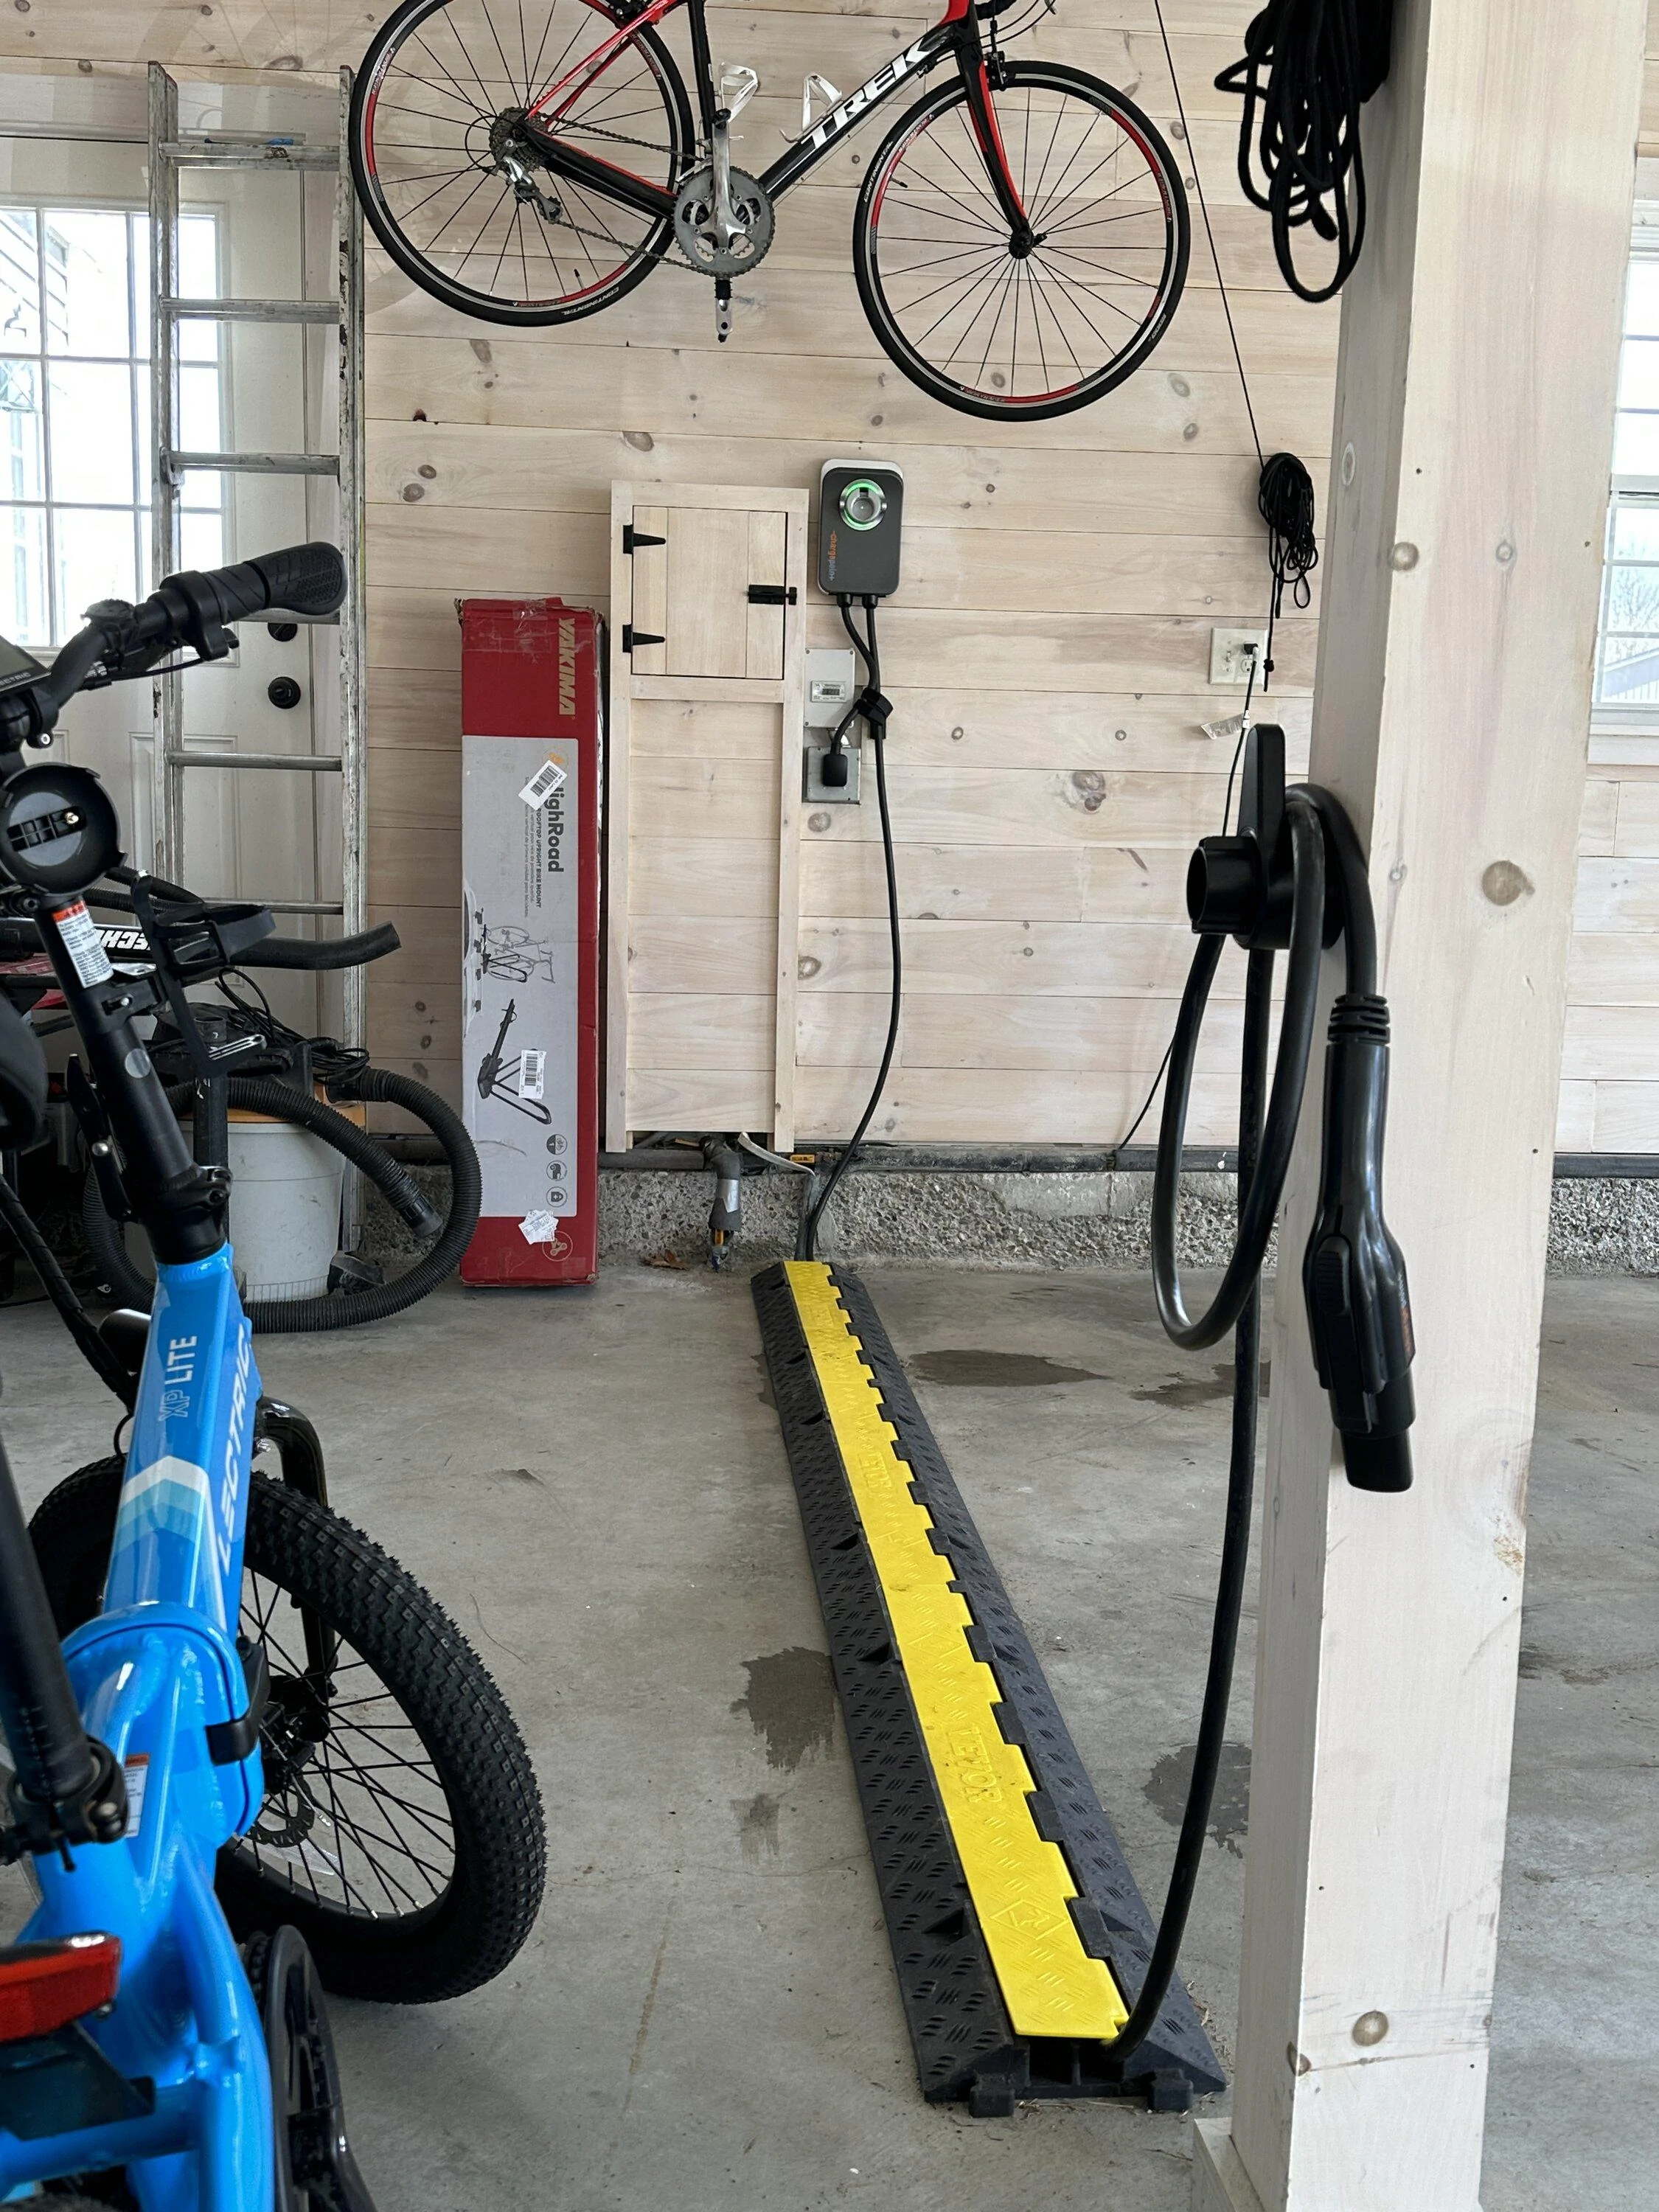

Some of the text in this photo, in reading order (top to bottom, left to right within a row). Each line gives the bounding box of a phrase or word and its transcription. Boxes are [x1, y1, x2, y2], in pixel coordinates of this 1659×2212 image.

[800, 37, 931, 148] TREK
[864, 141, 894, 203] CONTINENTAL
[561, 286, 619, 316] CONTINENTAL
[559, 618, 576, 715] YAKIMA
[158, 1335, 198, 1422] XP LITE
[218, 1323, 251, 1576] LECTRIC
